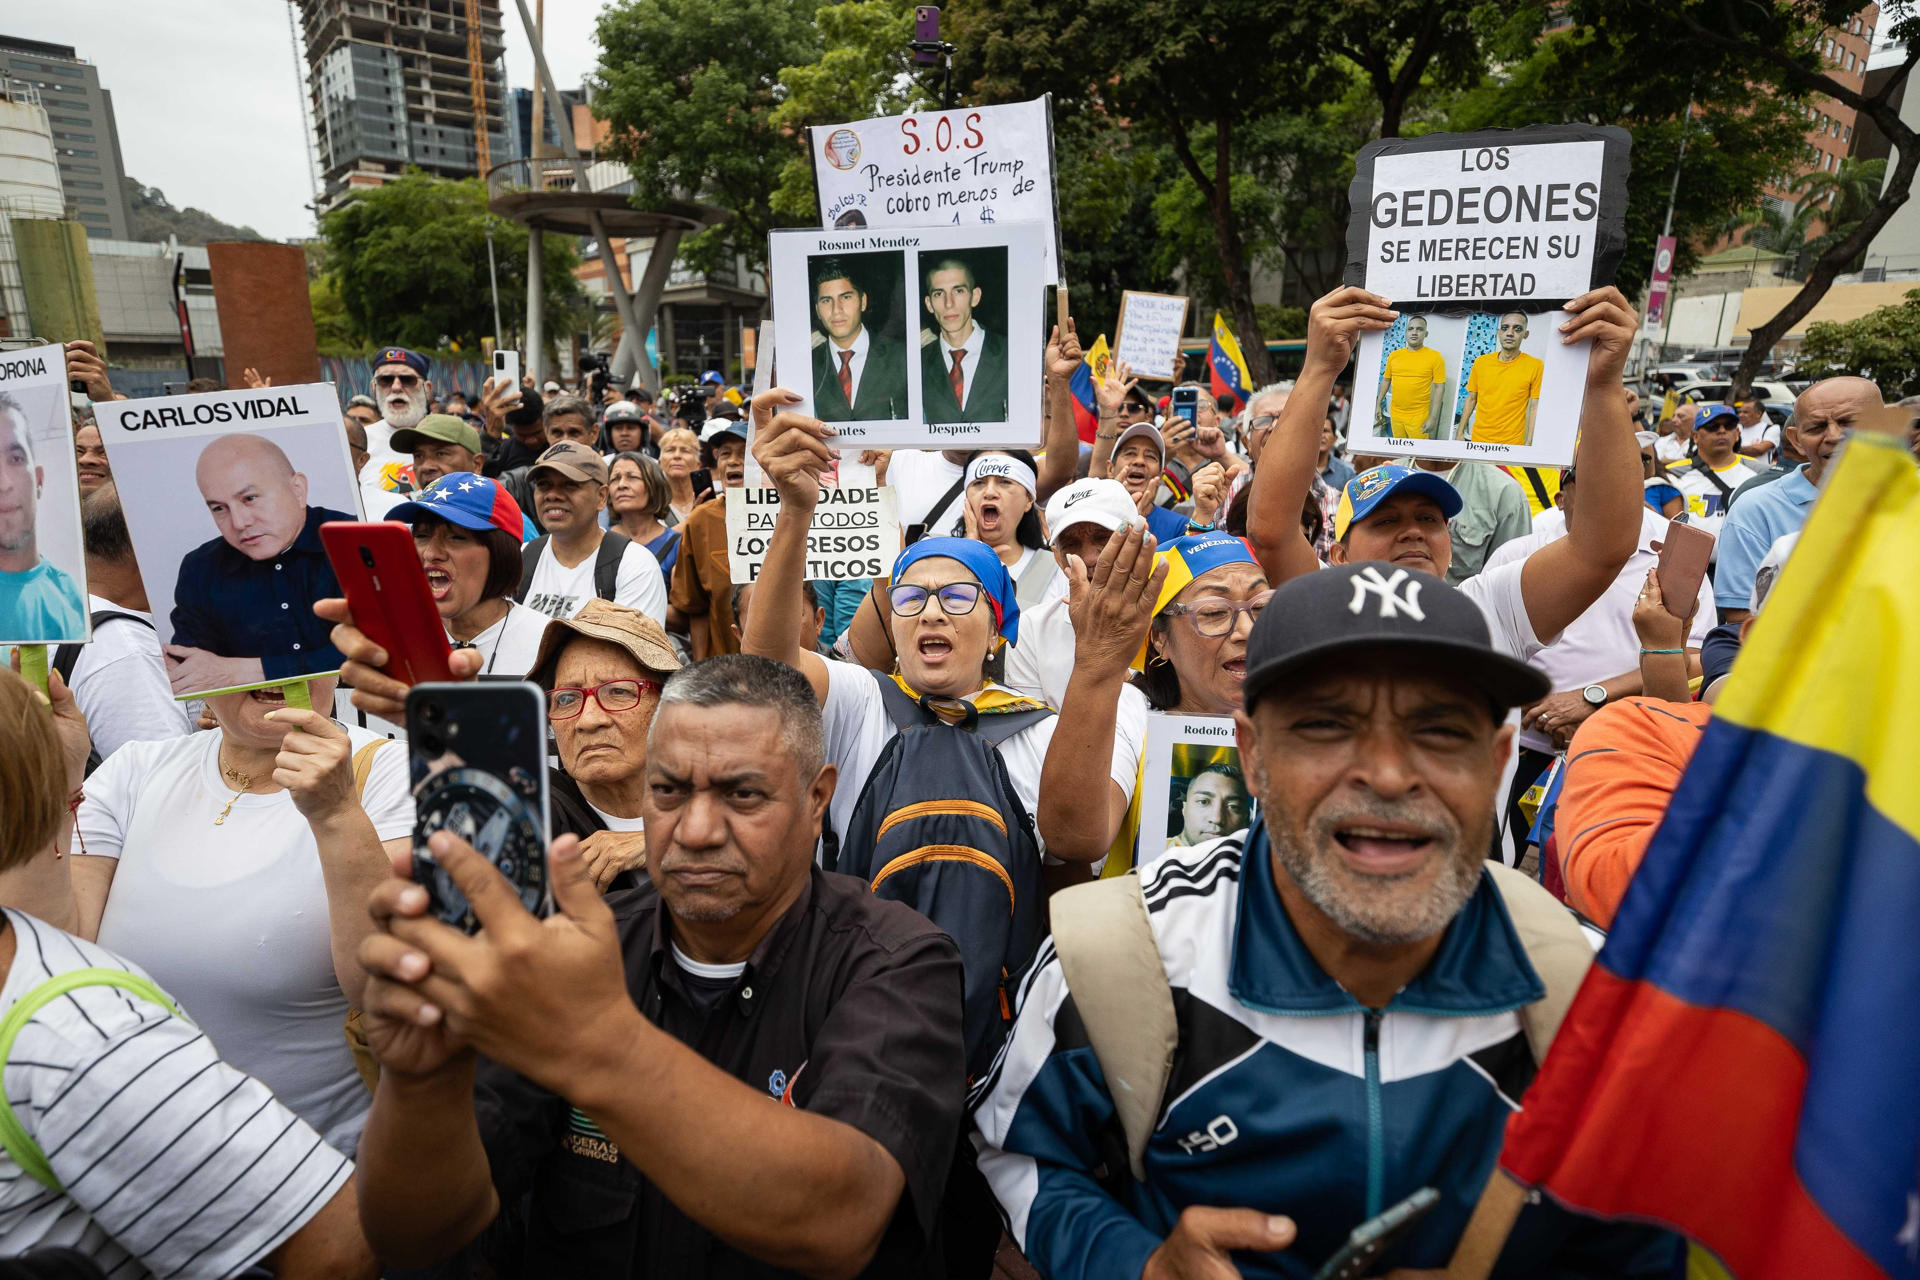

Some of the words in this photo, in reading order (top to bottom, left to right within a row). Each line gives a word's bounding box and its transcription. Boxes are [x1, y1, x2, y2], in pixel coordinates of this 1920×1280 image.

[901, 112, 984, 155] S.O.S
[860, 162, 961, 192] Presidente
[964, 151, 1024, 178] Trump
[1461, 147, 1510, 172] LOS
[886, 192, 930, 215] cobro
[937, 187, 998, 208] menos
[1012, 176, 1035, 196] de
[1371, 181, 1598, 229] GEDEONES
[818, 238, 865, 251] Rosmel
[869, 236, 920, 248] Mendez
[1380, 240, 1411, 263] SE
[1418, 235, 1539, 262] MERECEN
[1546, 235, 1581, 260] SU
[1416, 272, 1536, 298] LIBERTAD
[119, 402, 232, 431] CARLOS
[232, 396, 309, 420] VIDAL
[832, 426, 866, 436] ntes
[928, 423, 981, 435] Después
[1385, 438, 1415, 447] Antes
[745, 487, 880, 504] LIBDADE
[806, 534, 880, 553] RESOS
[1186, 539, 1242, 555] VENEZUELA
[749, 558, 882, 581] PTICOS
[1348, 566, 1426, 622] NY
[1184, 725, 1228, 736] Rodolfo
